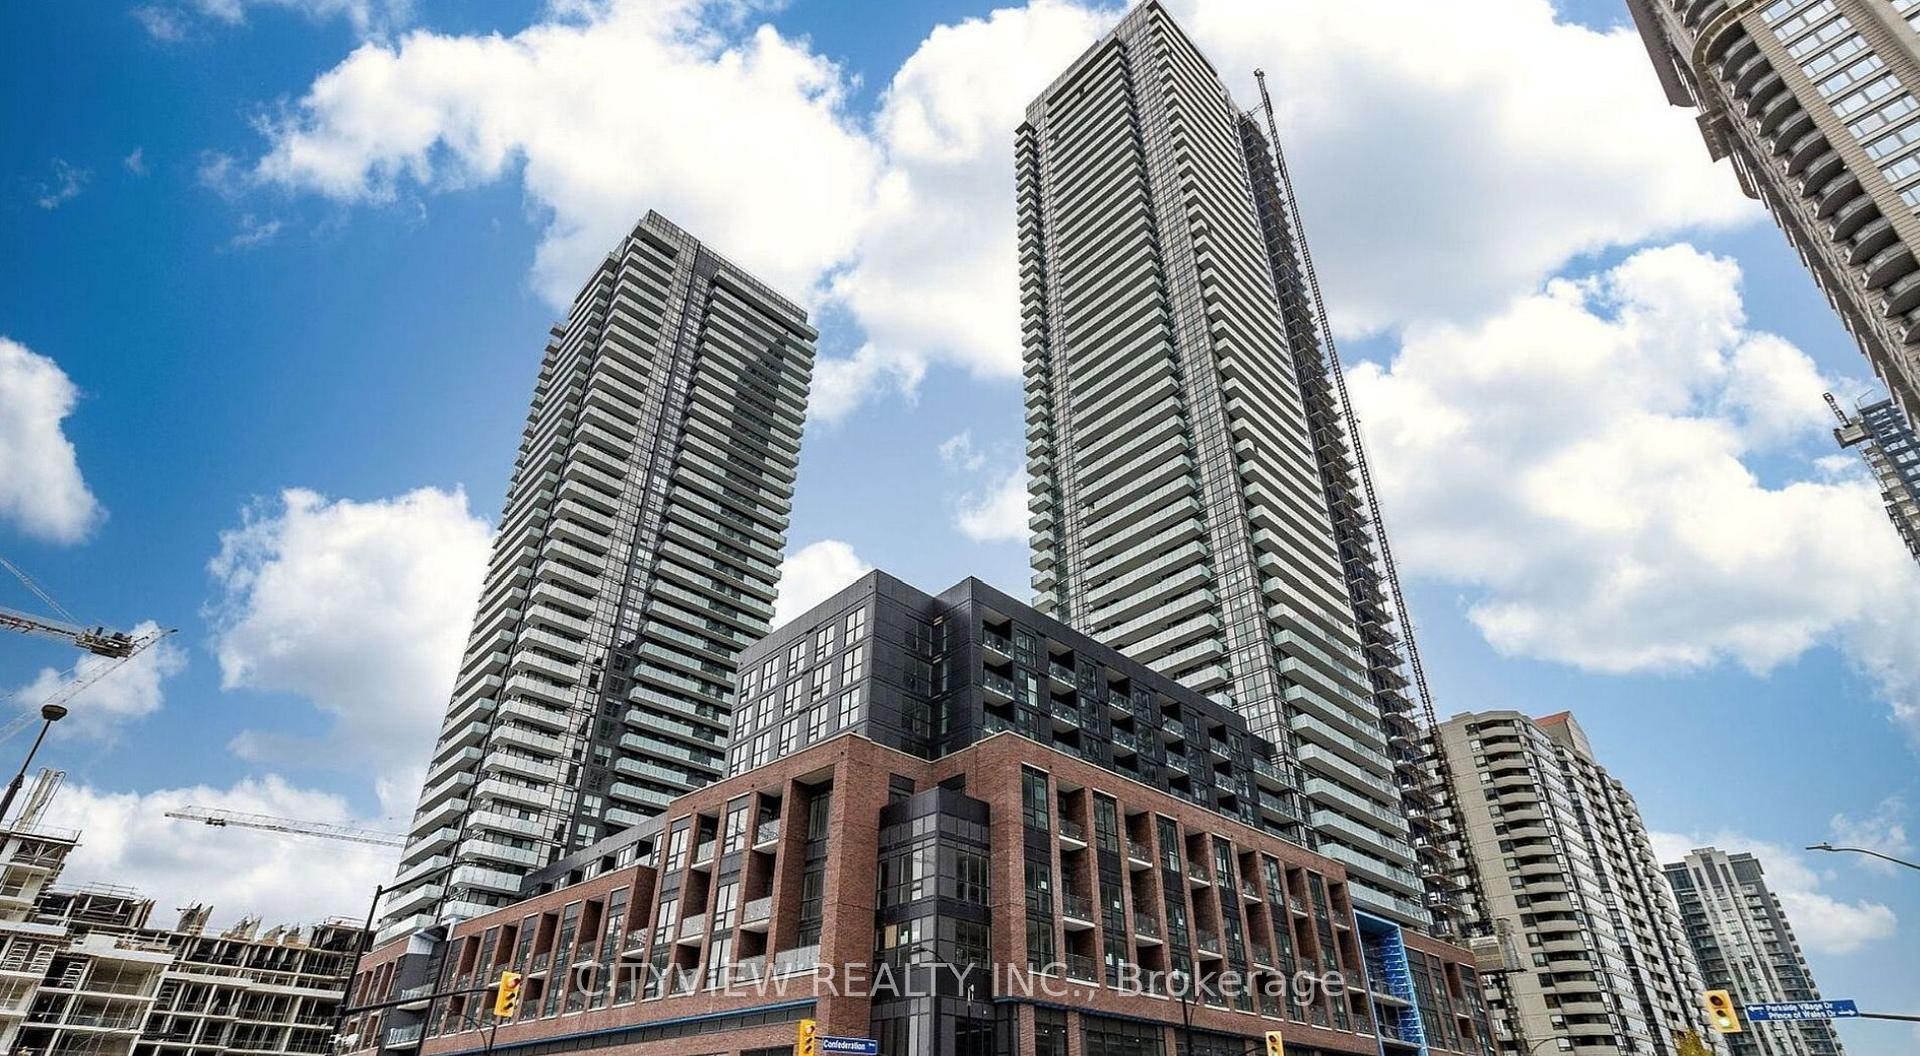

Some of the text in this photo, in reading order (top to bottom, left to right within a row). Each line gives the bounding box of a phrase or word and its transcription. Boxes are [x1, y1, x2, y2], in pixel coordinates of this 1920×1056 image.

[1799, 1003, 1823, 1012] Village
[1824, 1002, 1833, 1010] Dr
[1802, 1010, 1826, 1018] Wales
[1827, 1009, 1836, 1017] Dr
[823, 1040, 866, 1050] Confederation
